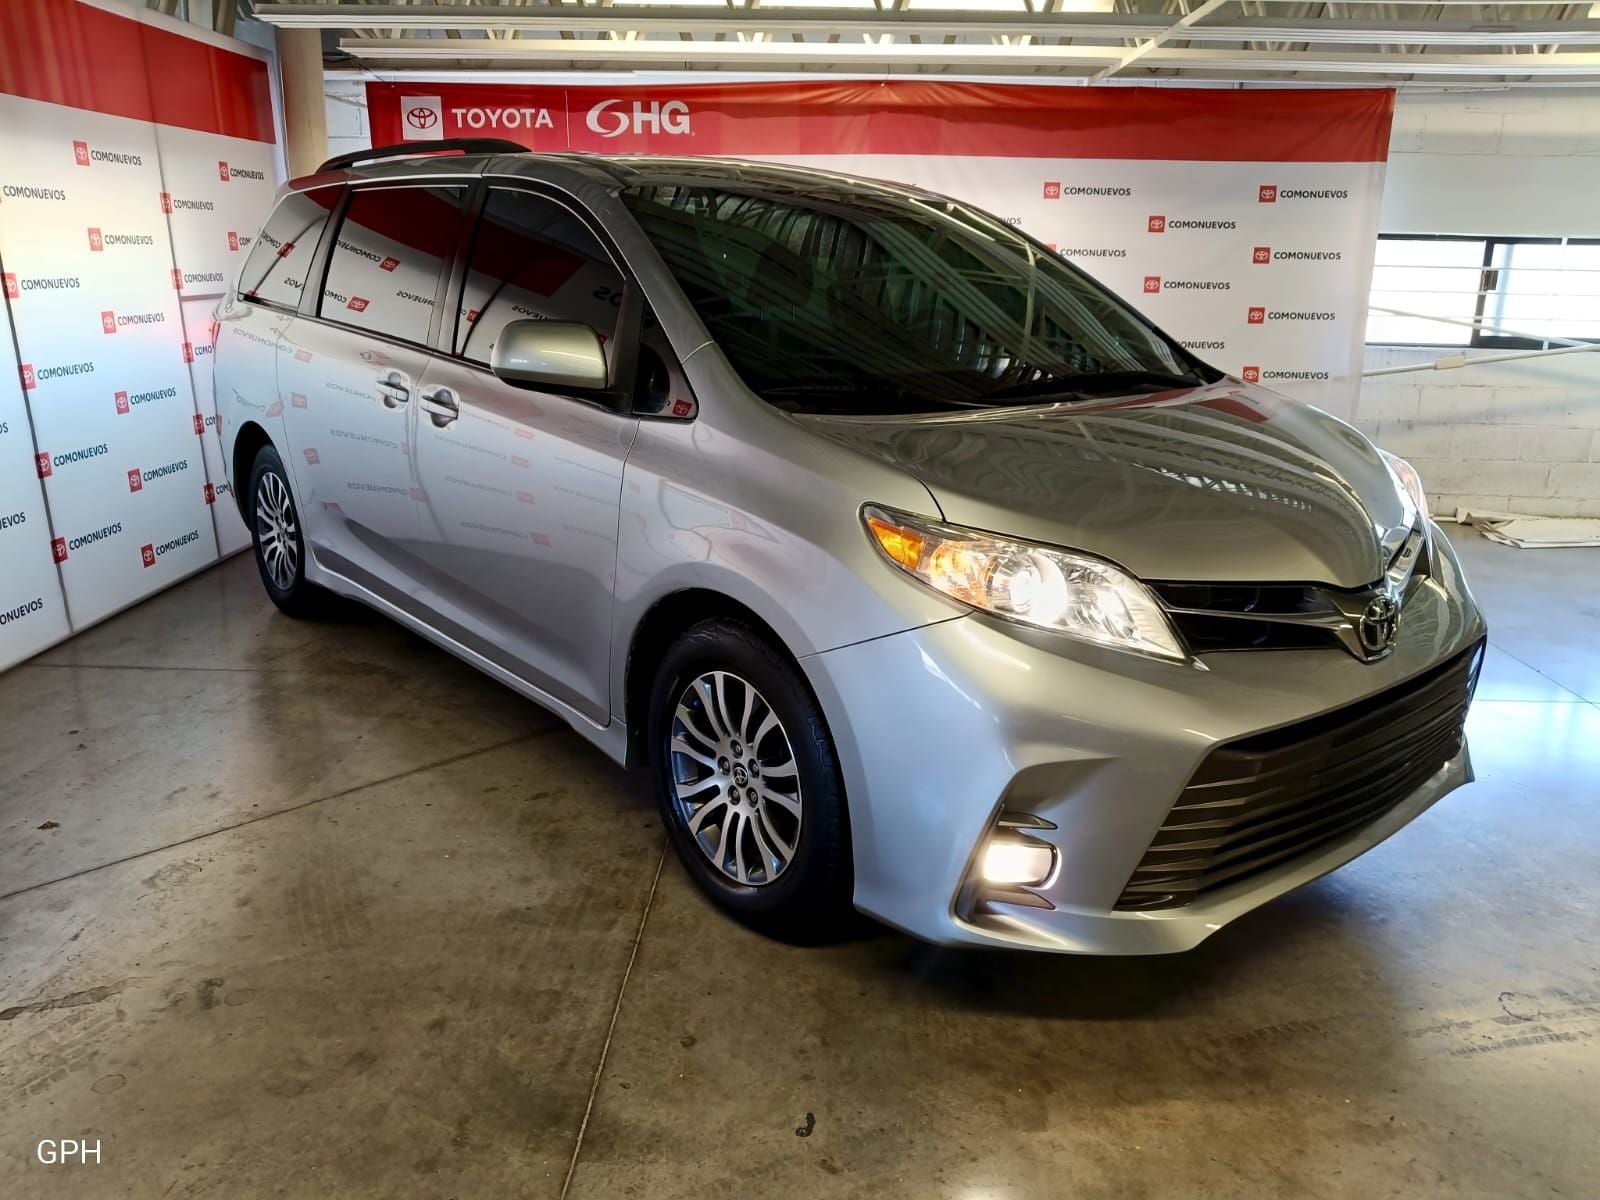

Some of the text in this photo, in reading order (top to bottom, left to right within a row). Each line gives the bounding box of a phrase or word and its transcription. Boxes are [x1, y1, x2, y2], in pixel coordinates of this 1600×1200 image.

[452, 108, 553, 129] TOYOTA
[91, 150, 142, 166] COMONUEVOS
[230, 168, 264, 180] COMONUEVOS
[3, 185, 66, 201] COMONUEVOS
[1064, 187, 1131, 197] COMONUEVOS
[1280, 190, 1348, 200] COMONUEVOS
[173, 199, 214, 211] COMONUEVOS
[1168, 220, 1236, 230] COMONUEVOS
[104, 234, 153, 246] COMONUEVOS
[1060, 248, 1126, 258] COMONUEVOS
[1274, 251, 1341, 261] COMONUEVOS
[21, 277, 80, 291] COMONUEVOS
[184, 273, 224, 283] COMONUEVOS
[1163, 280, 1230, 290] COMONUEVOS
[117, 312, 165, 326] COMONUEVOS
[1268, 311, 1335, 321] COMONUEVOS
[1178, 341, 1225, 350] ONUEVOS
[37, 362, 95, 381] COMONUEVOS
[1262, 370, 1329, 380] COMONUEVOS
[130, 387, 177, 405] COMONUEVOS
[53, 443, 108, 467] COMONUEVOS
[143, 459, 188, 482] COMONUEVOS
[69, 522, 122, 550] COMONUEVOS
[155, 530, 199, 556] COMONUEVOS
